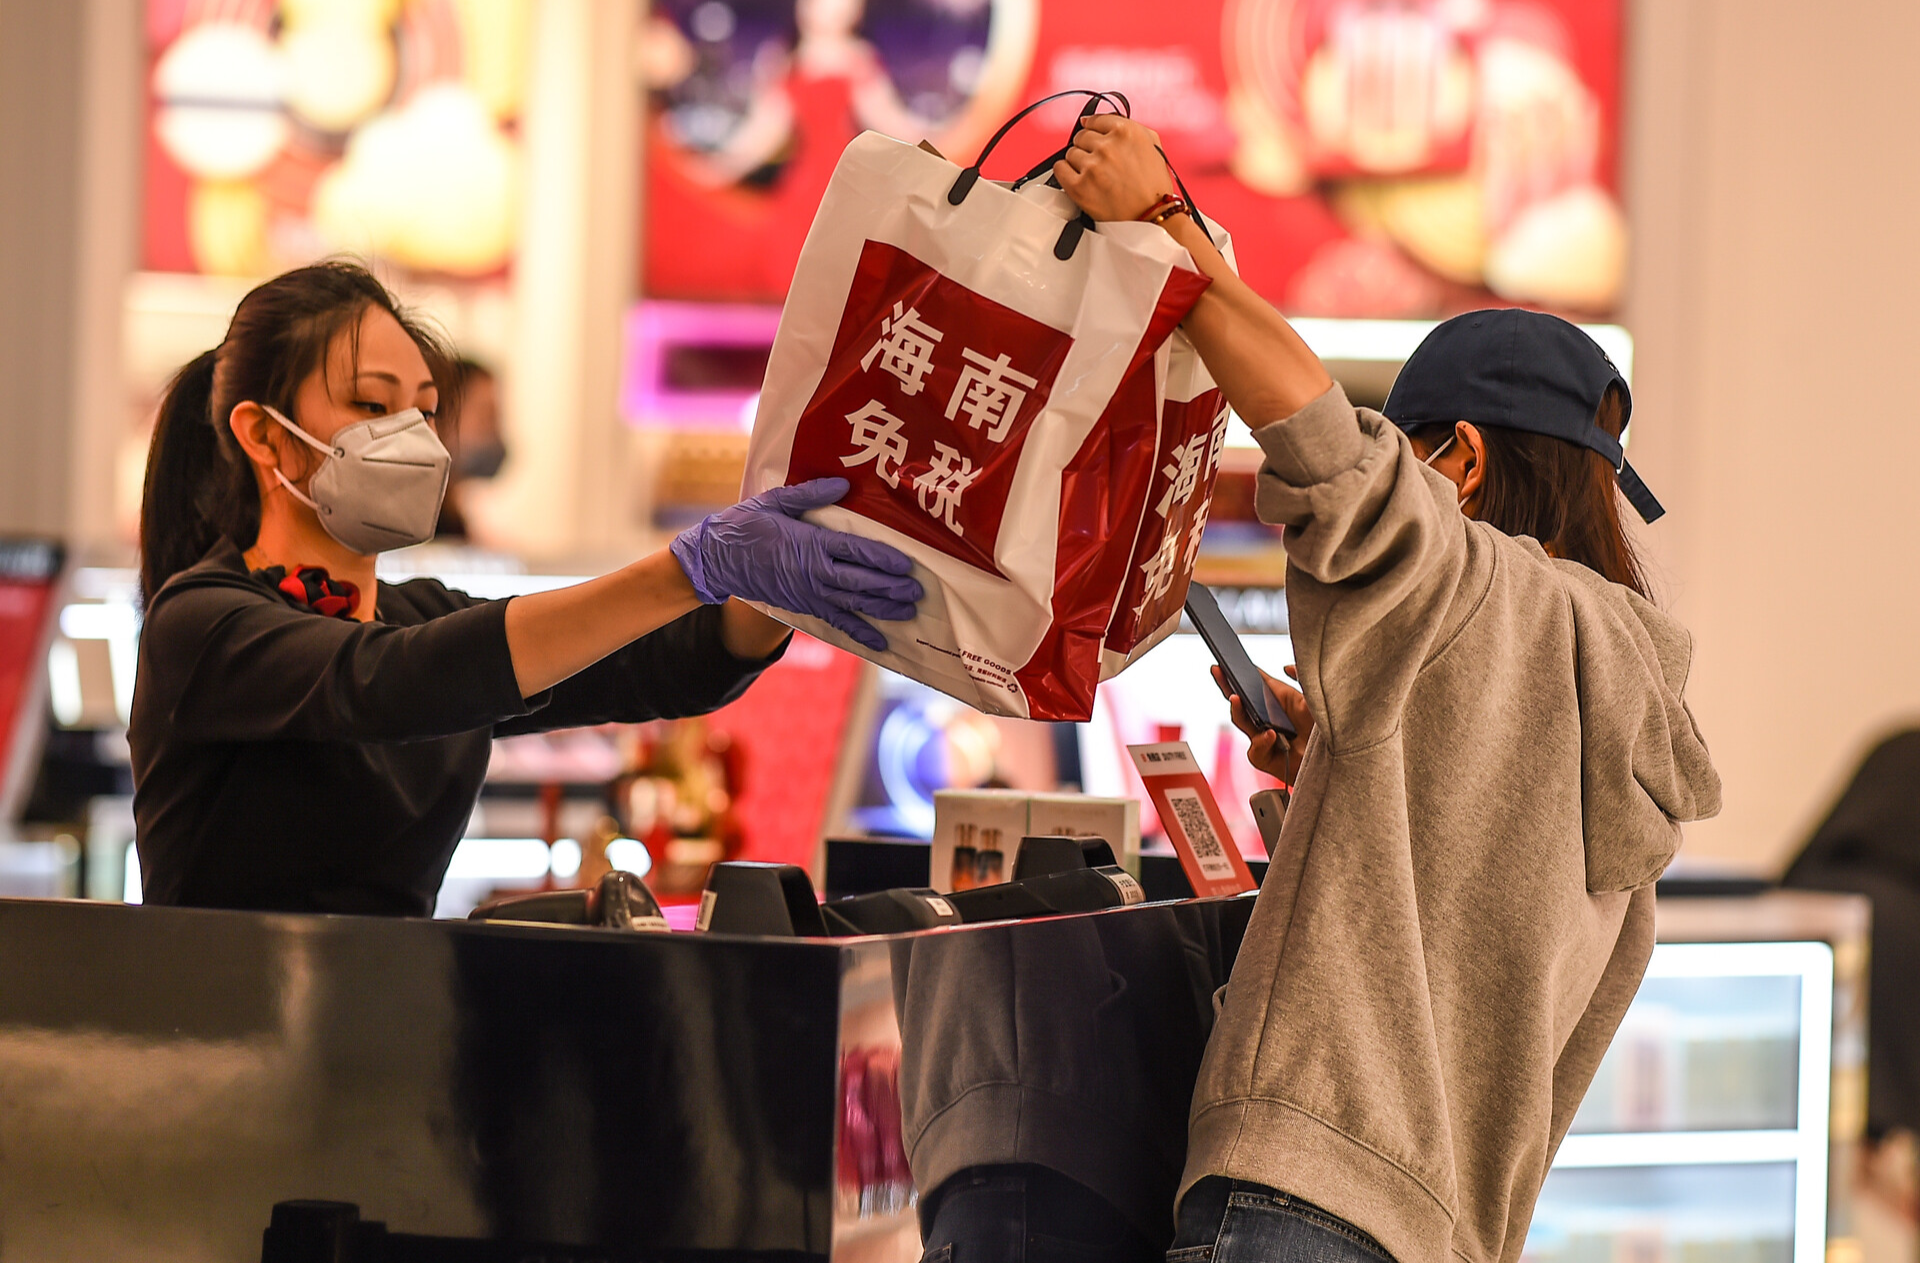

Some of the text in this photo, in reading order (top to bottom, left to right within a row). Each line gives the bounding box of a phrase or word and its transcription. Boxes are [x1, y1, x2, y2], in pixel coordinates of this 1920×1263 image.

[860, 300, 1038, 443] 海南
[839, 398, 983, 537] 免税
[962, 650, 982, 662] FREE
[983, 658, 1011, 675] GOODS
